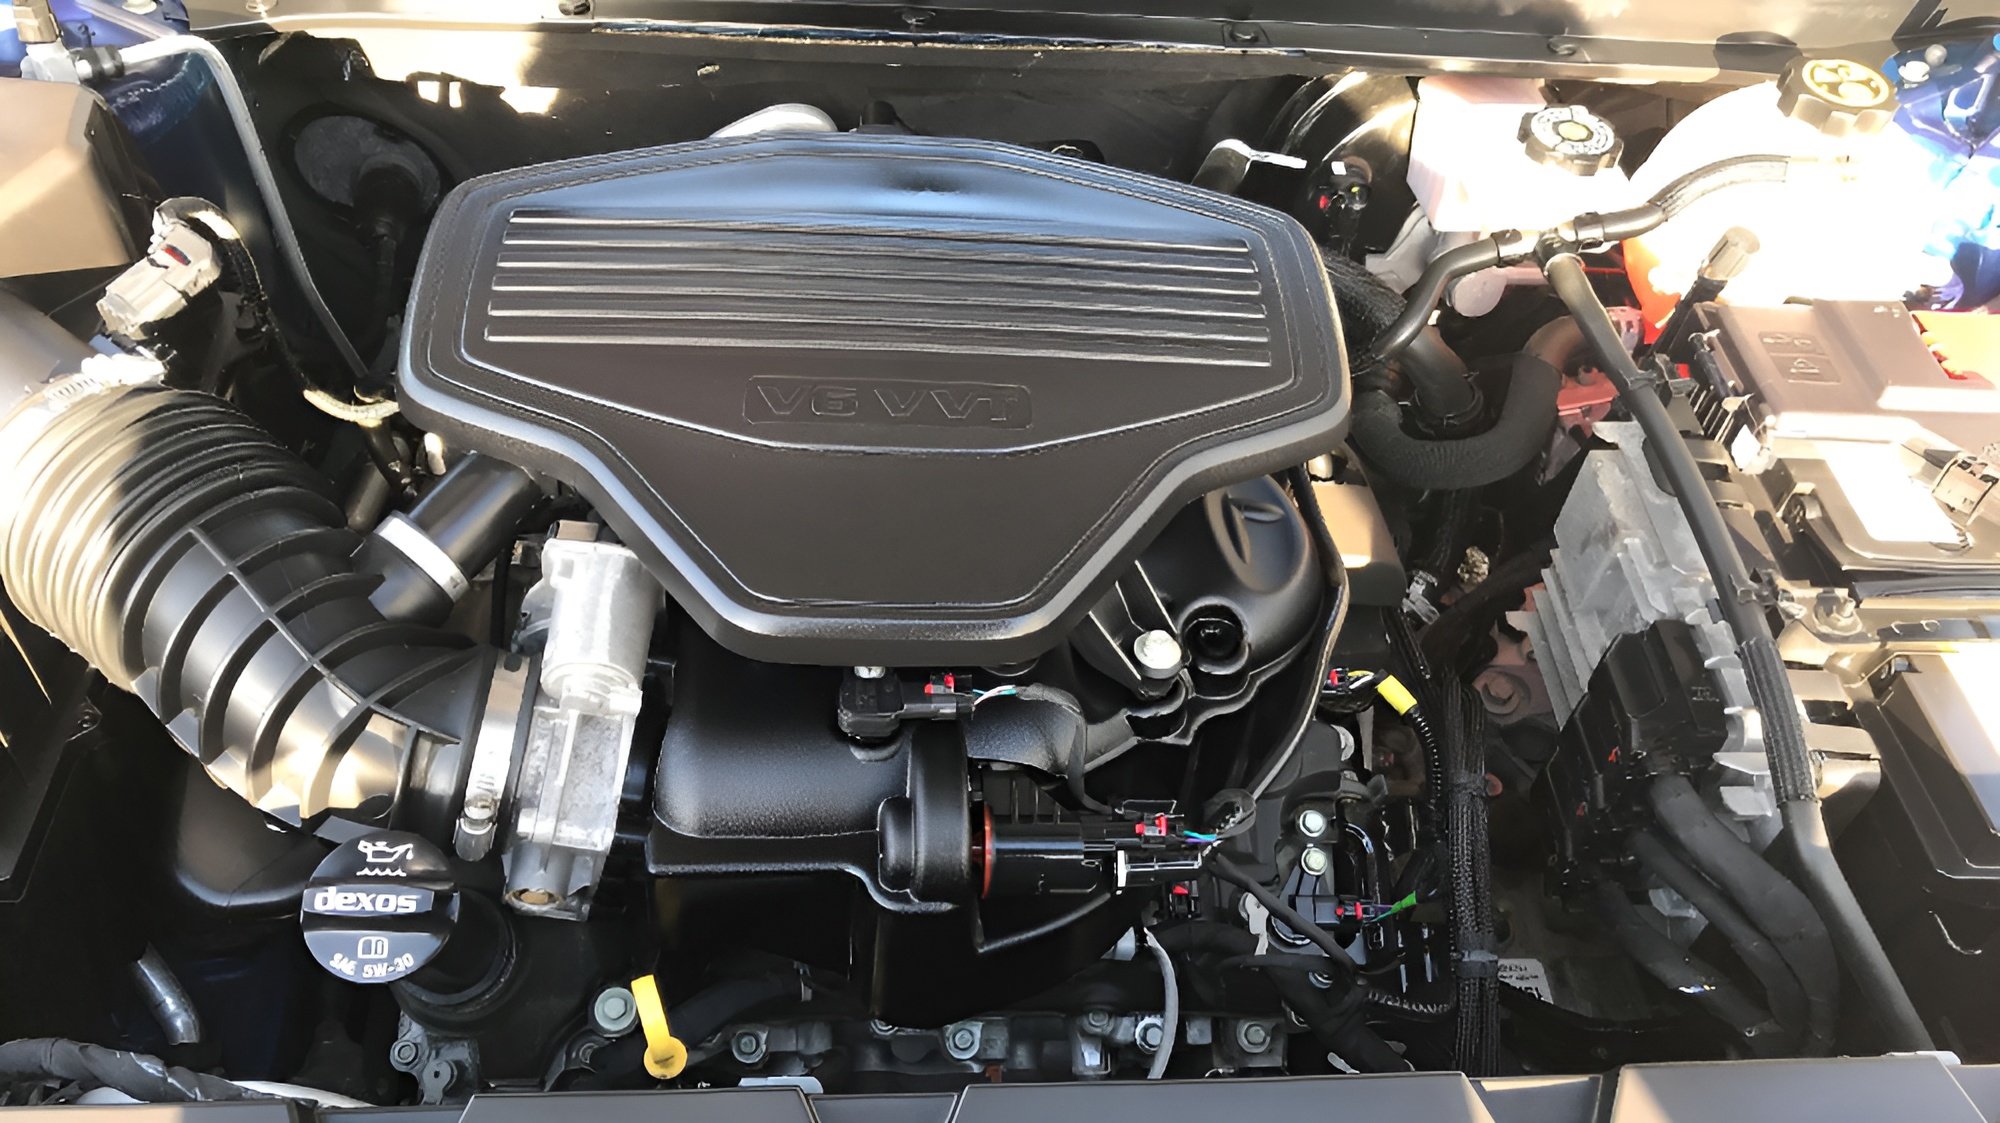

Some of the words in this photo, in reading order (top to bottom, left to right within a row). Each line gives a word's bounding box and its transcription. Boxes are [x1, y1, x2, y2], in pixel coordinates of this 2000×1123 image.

[757, 385, 858, 415] V6
[874, 389, 1019, 421] VVT
[314, 886, 420, 913] dexos
[329, 953, 357, 976] SAE
[362, 953, 414, 978] 5W-30
